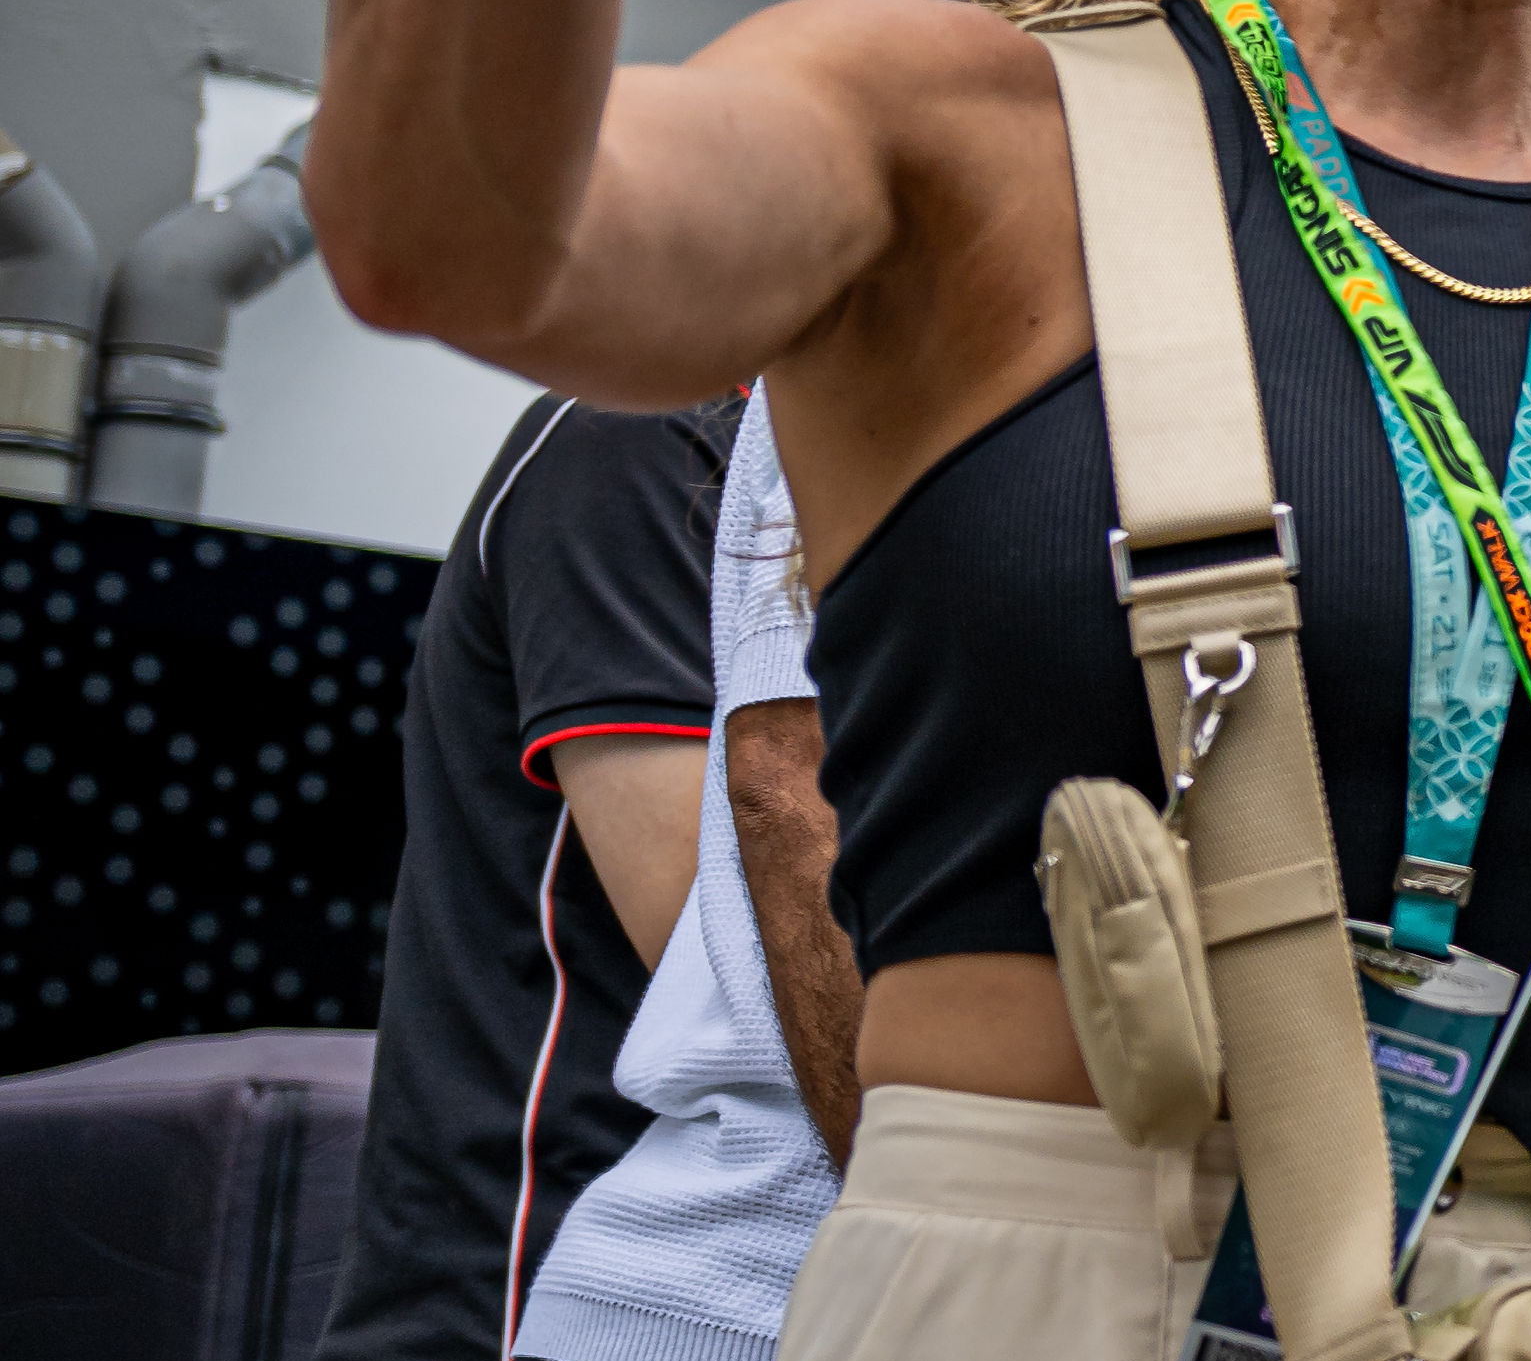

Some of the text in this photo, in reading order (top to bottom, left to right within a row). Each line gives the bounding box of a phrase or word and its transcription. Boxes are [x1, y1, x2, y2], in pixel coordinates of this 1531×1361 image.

[1363, 315, 1413, 379] VIP
[1428, 521, 1453, 584] SAT
[1475, 519, 1521, 589] WALK
